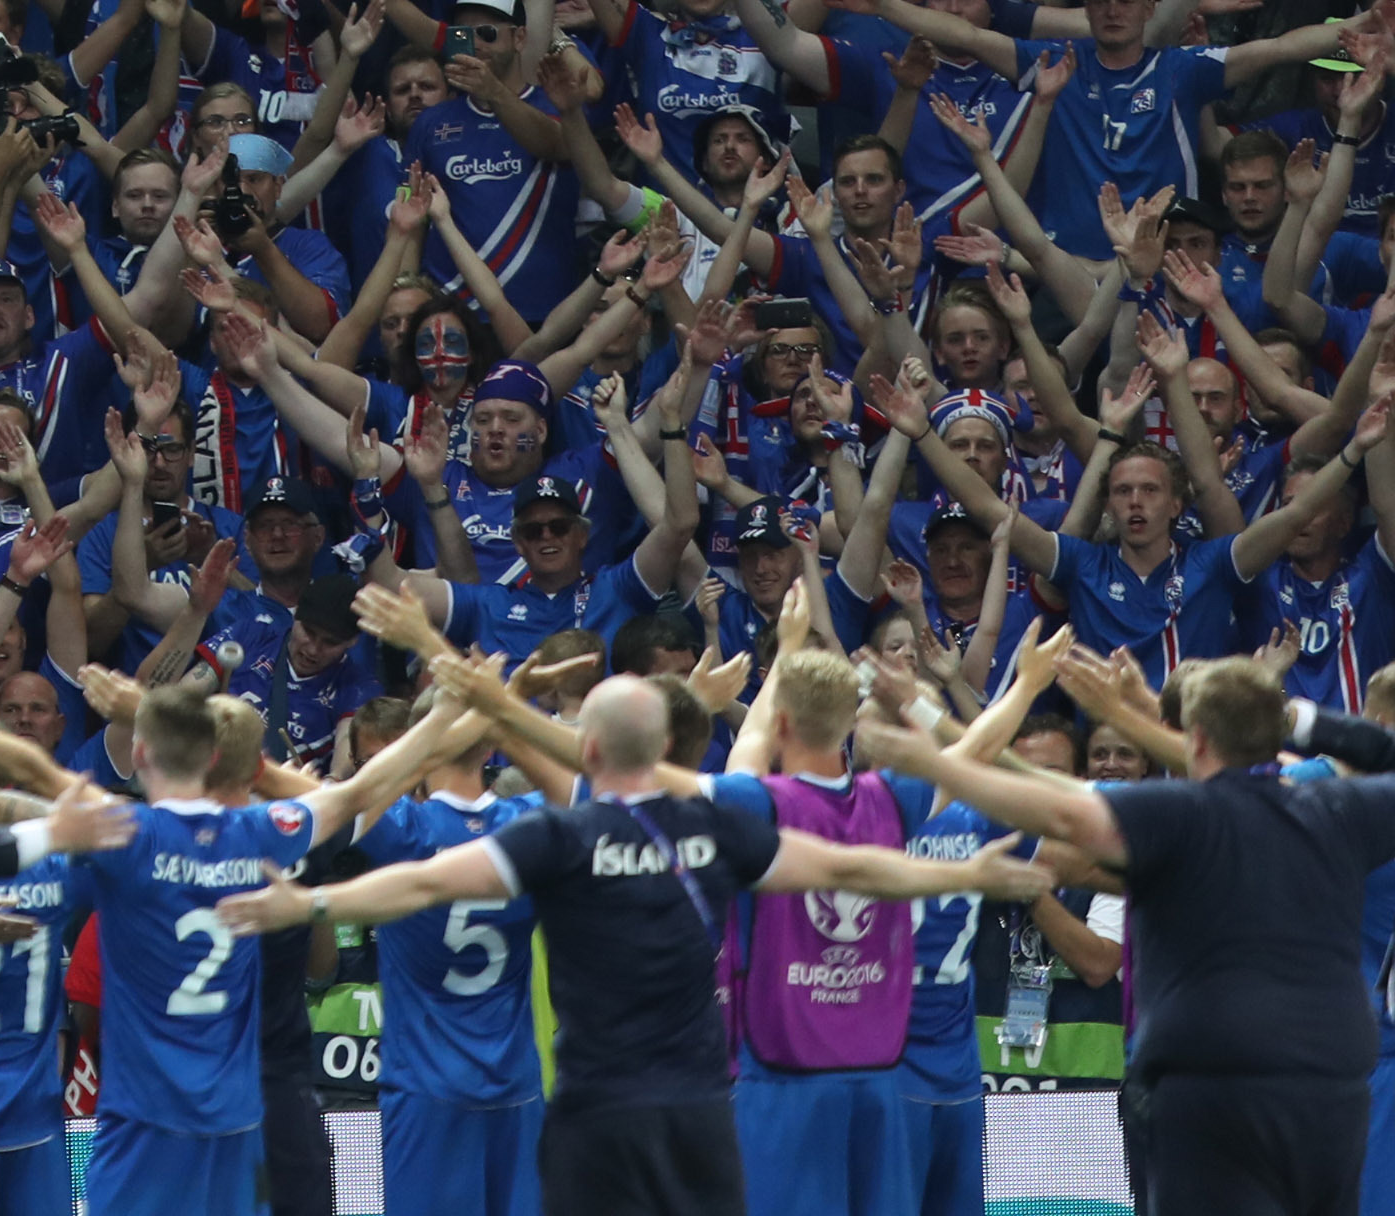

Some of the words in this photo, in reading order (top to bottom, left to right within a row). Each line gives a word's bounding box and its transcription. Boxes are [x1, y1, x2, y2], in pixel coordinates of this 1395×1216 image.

[257, 88, 289, 124] 10
[657, 84, 741, 111] Carlsberg
[444, 150, 522, 176] Carlsberg
[1298, 617, 1331, 654] 10
[152, 852, 264, 887] SÆVARSSON
[165, 906, 236, 1016] 2
[441, 899, 510, 997] 5
[811, 988, 862, 1005] FRANCE
